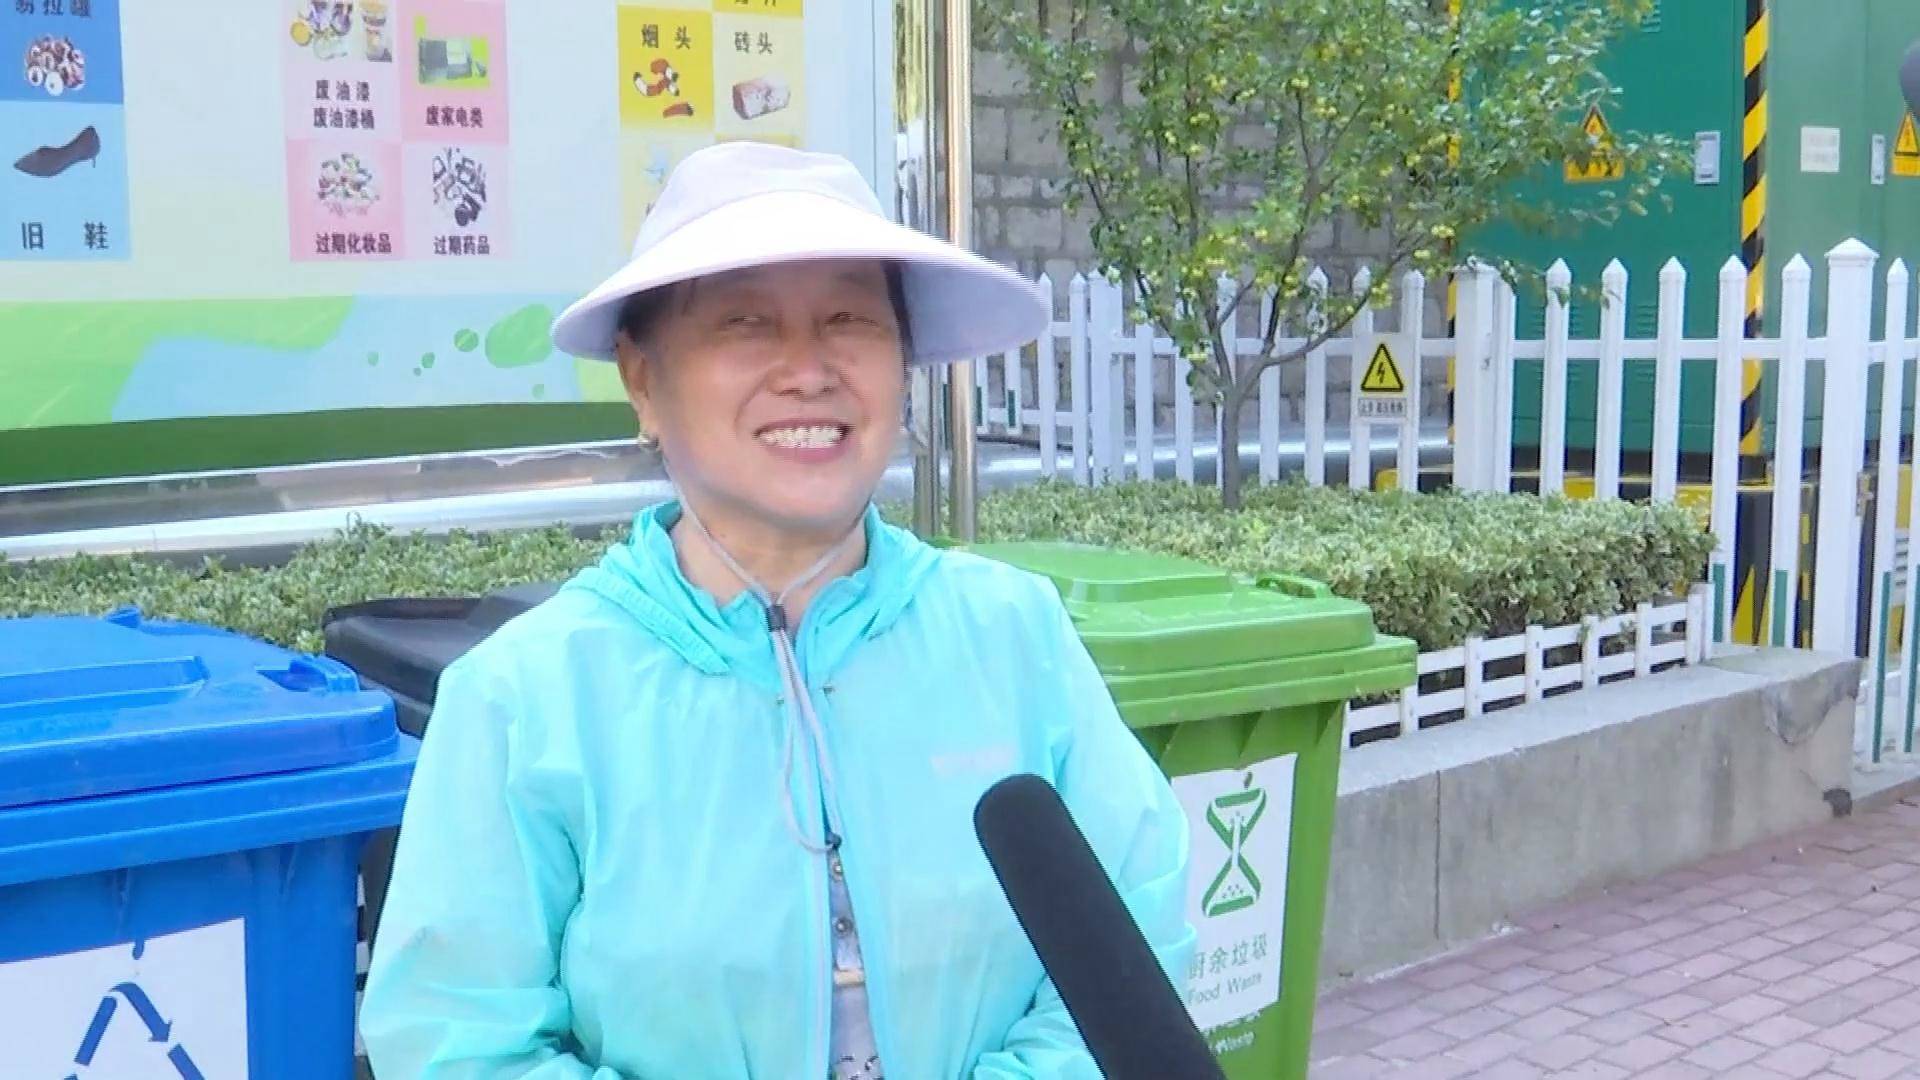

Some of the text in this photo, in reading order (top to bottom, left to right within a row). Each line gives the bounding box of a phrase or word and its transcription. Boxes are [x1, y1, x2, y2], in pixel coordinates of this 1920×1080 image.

[641, 24, 691, 50] 烟头
[734, 31, 773, 54] 砖头
[315, 79, 370, 101] 废油漆
[313, 107, 375, 129] 废油漆桶
[426, 105, 483, 128] 废家电类
[21, 222, 109, 250] 旧鞋
[315, 232, 392, 255] 过期化妆品
[433, 235, 491, 256] 过期药品
[1187, 983, 1221, 1004] Food
